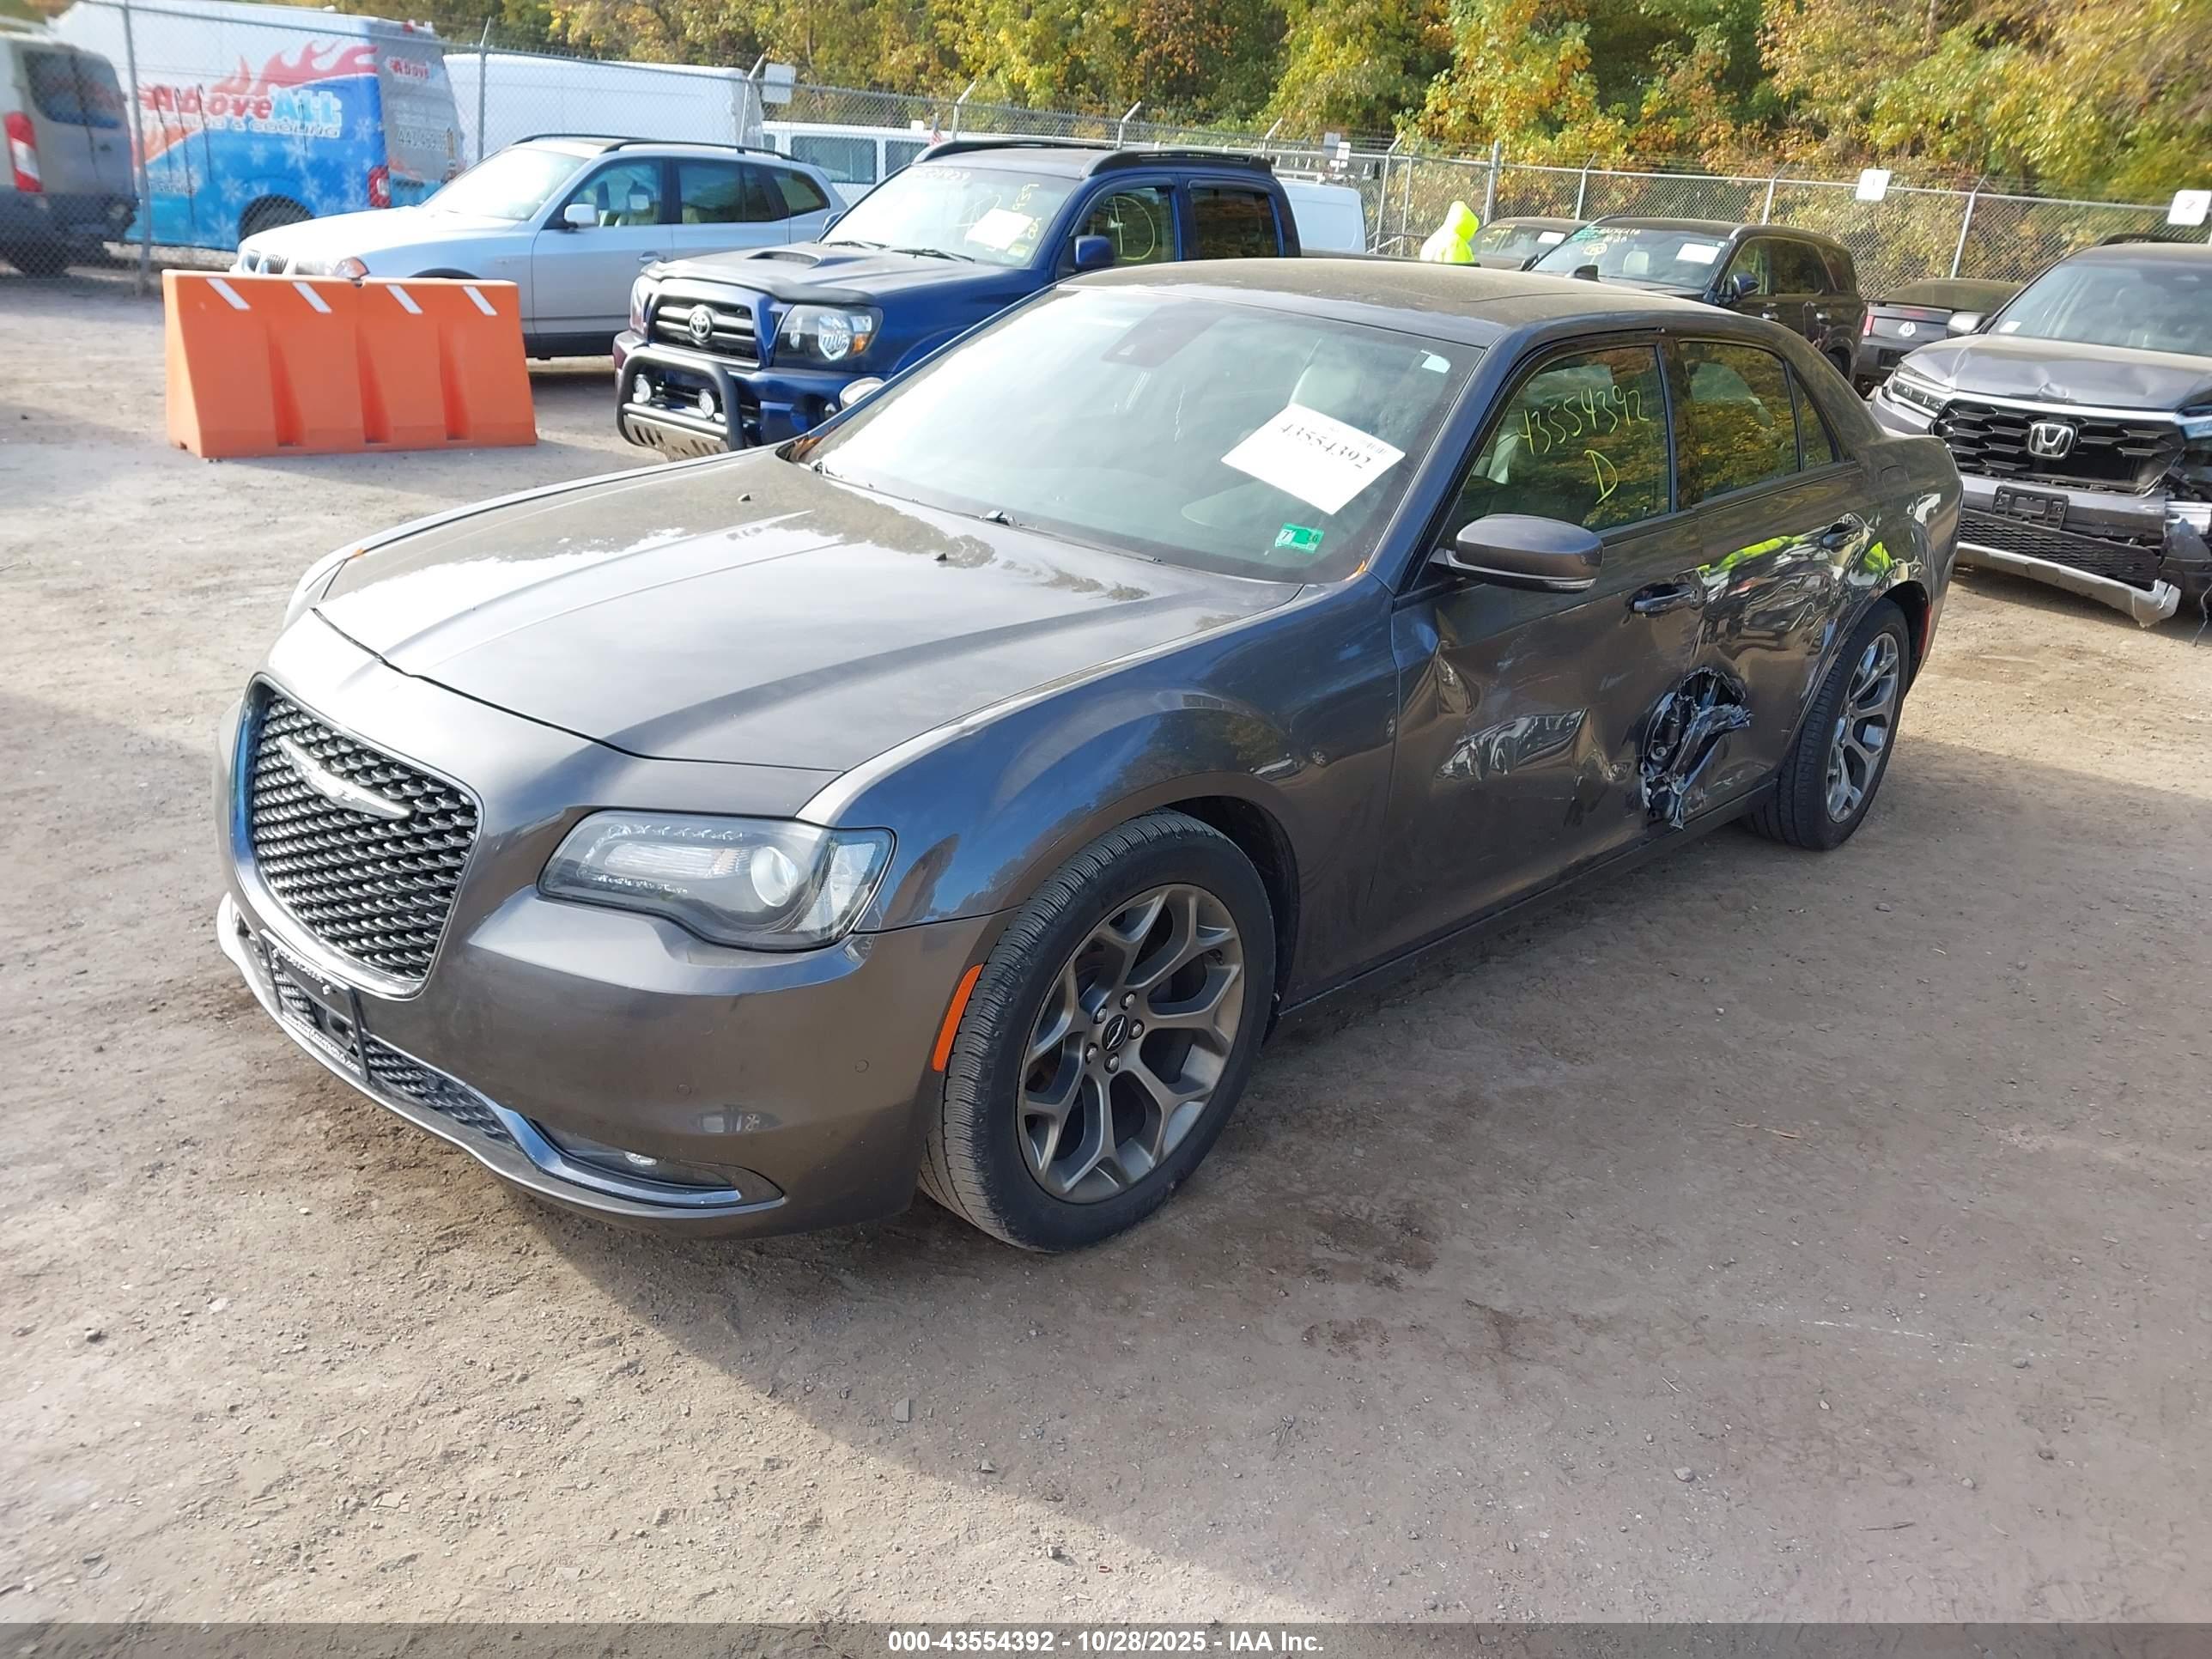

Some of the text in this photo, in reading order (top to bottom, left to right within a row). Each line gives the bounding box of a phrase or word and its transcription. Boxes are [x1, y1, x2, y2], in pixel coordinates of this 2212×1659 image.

[1280, 423, 1372, 470] 43554392
[1516, 385, 1650, 456] 43554392
[1583, 449, 1619, 505] D
